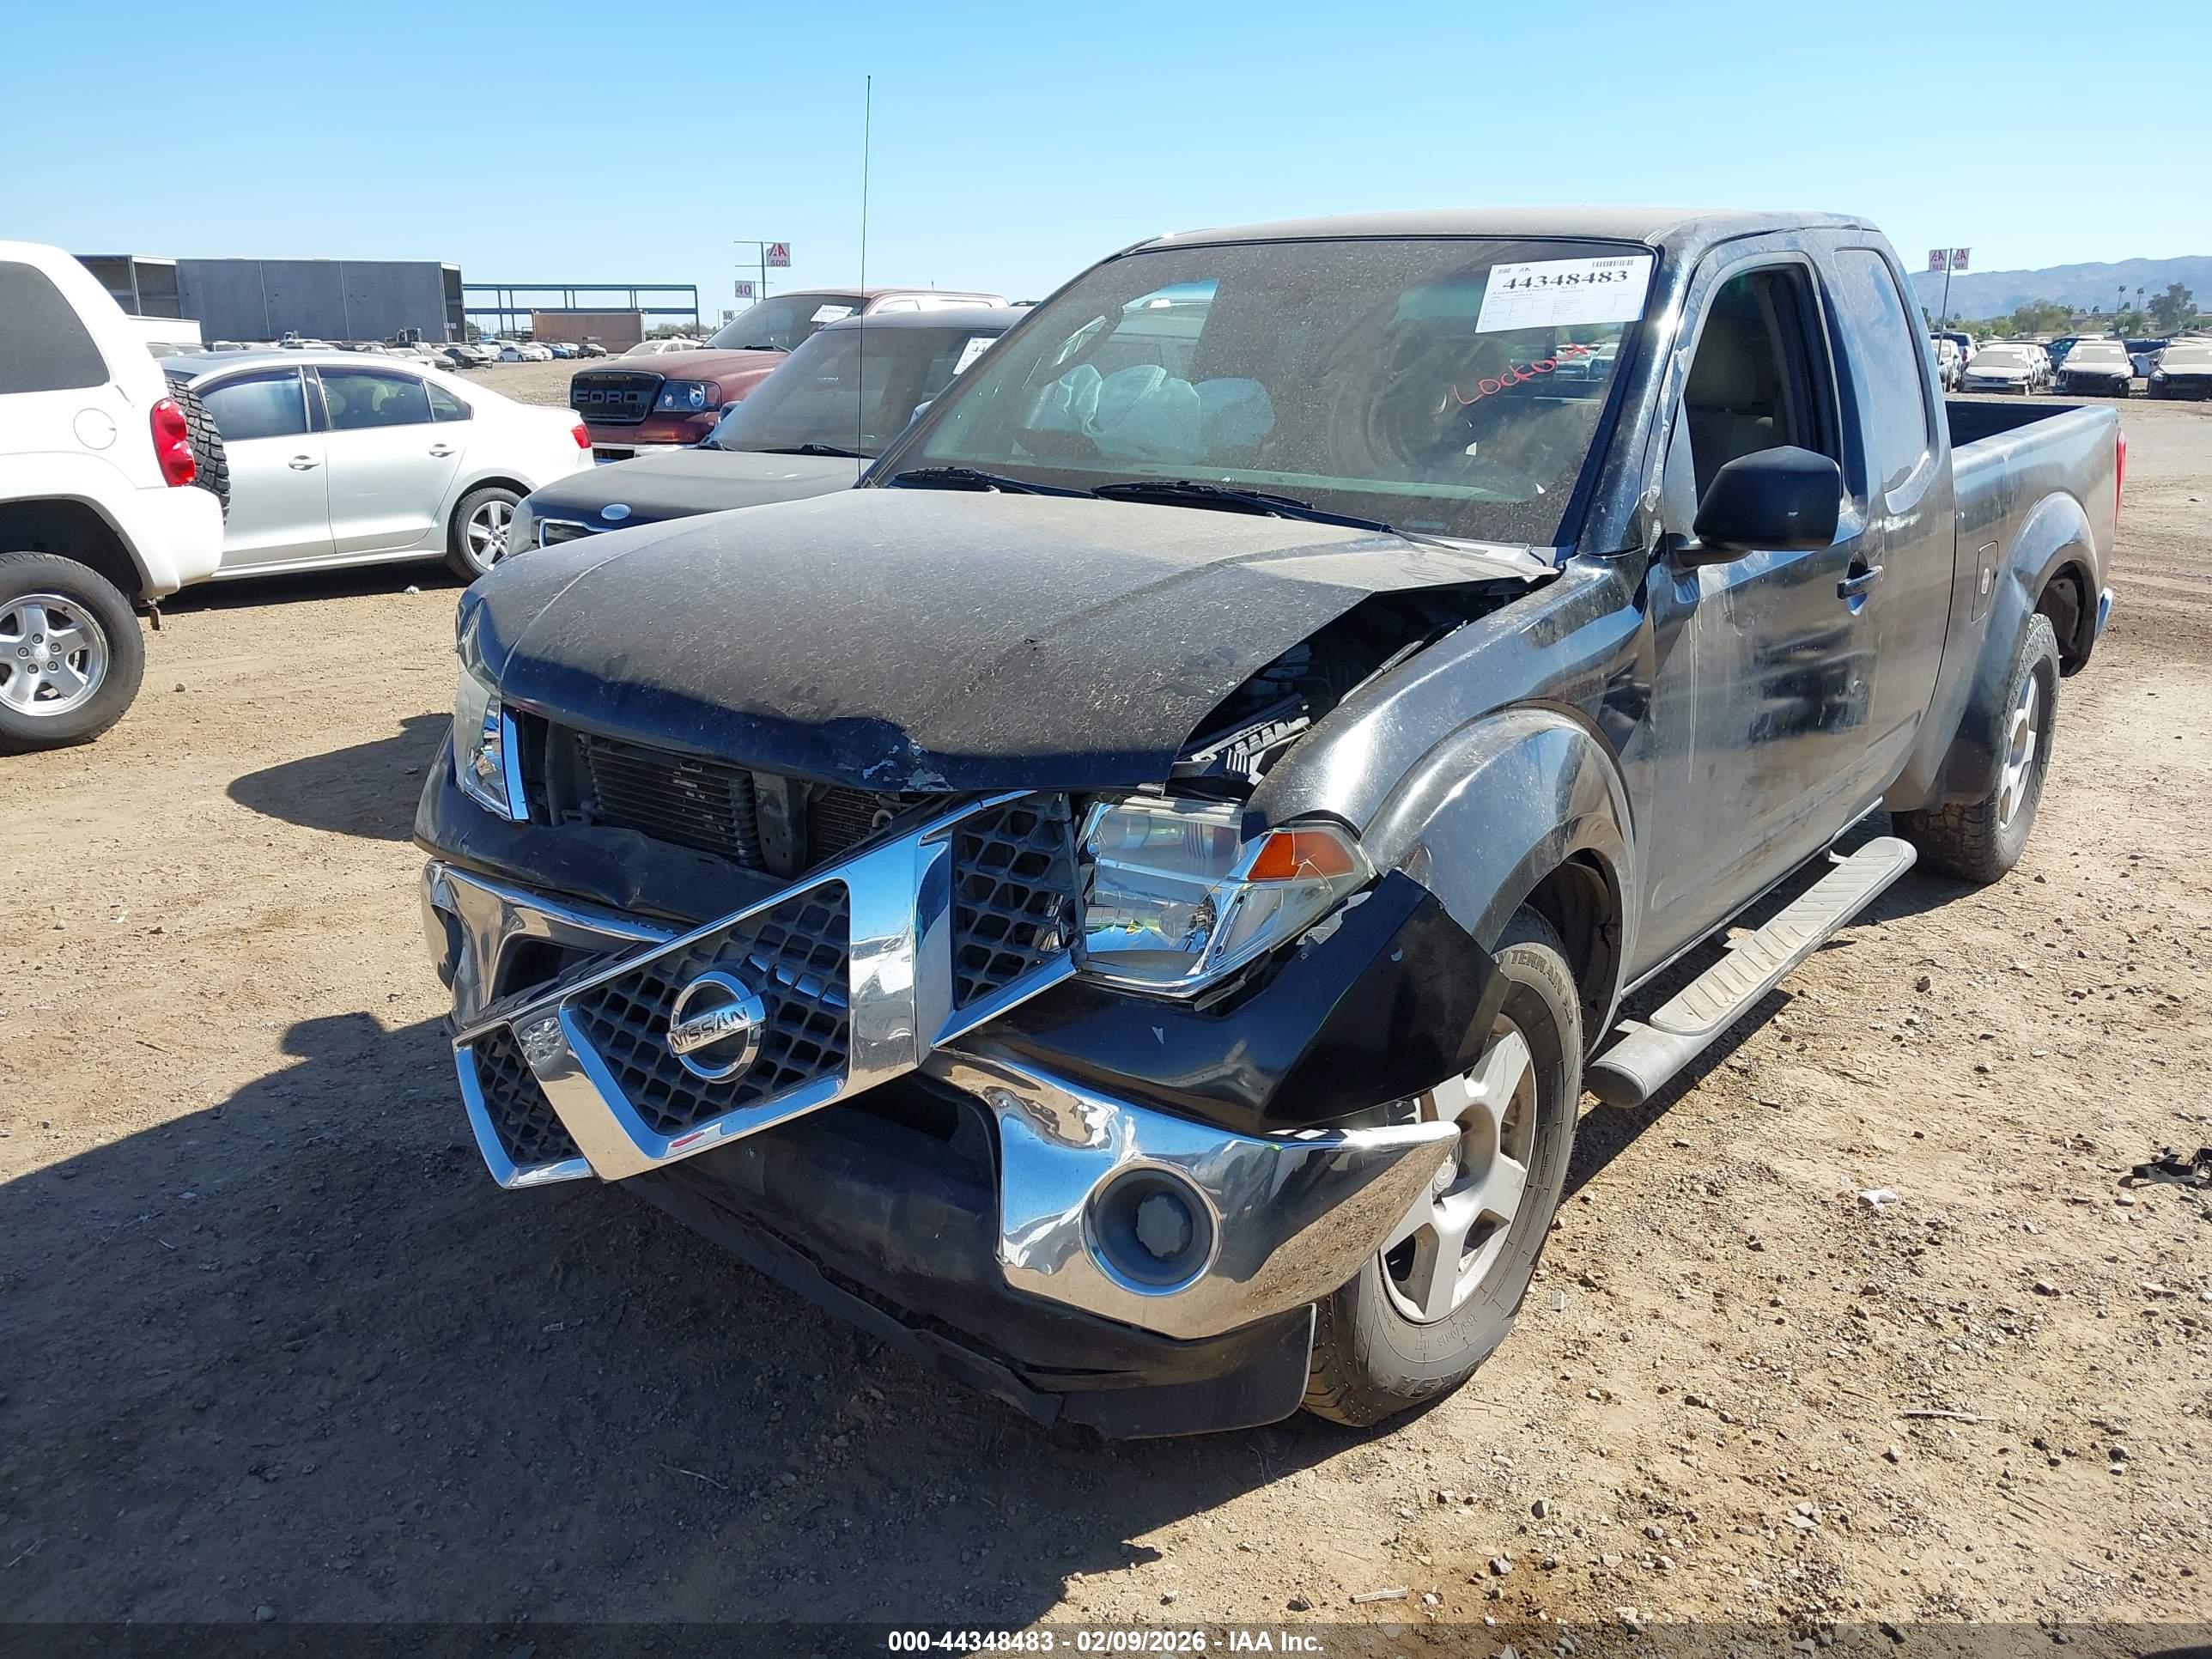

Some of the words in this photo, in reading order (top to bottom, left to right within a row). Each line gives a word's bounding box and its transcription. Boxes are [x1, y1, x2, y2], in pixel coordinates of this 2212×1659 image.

[1503, 270, 1628, 290] 44348483
[736, 284, 751, 296] 40
[574, 389, 640, 404] FORD
[670, 1006, 748, 1052] NISSAN
